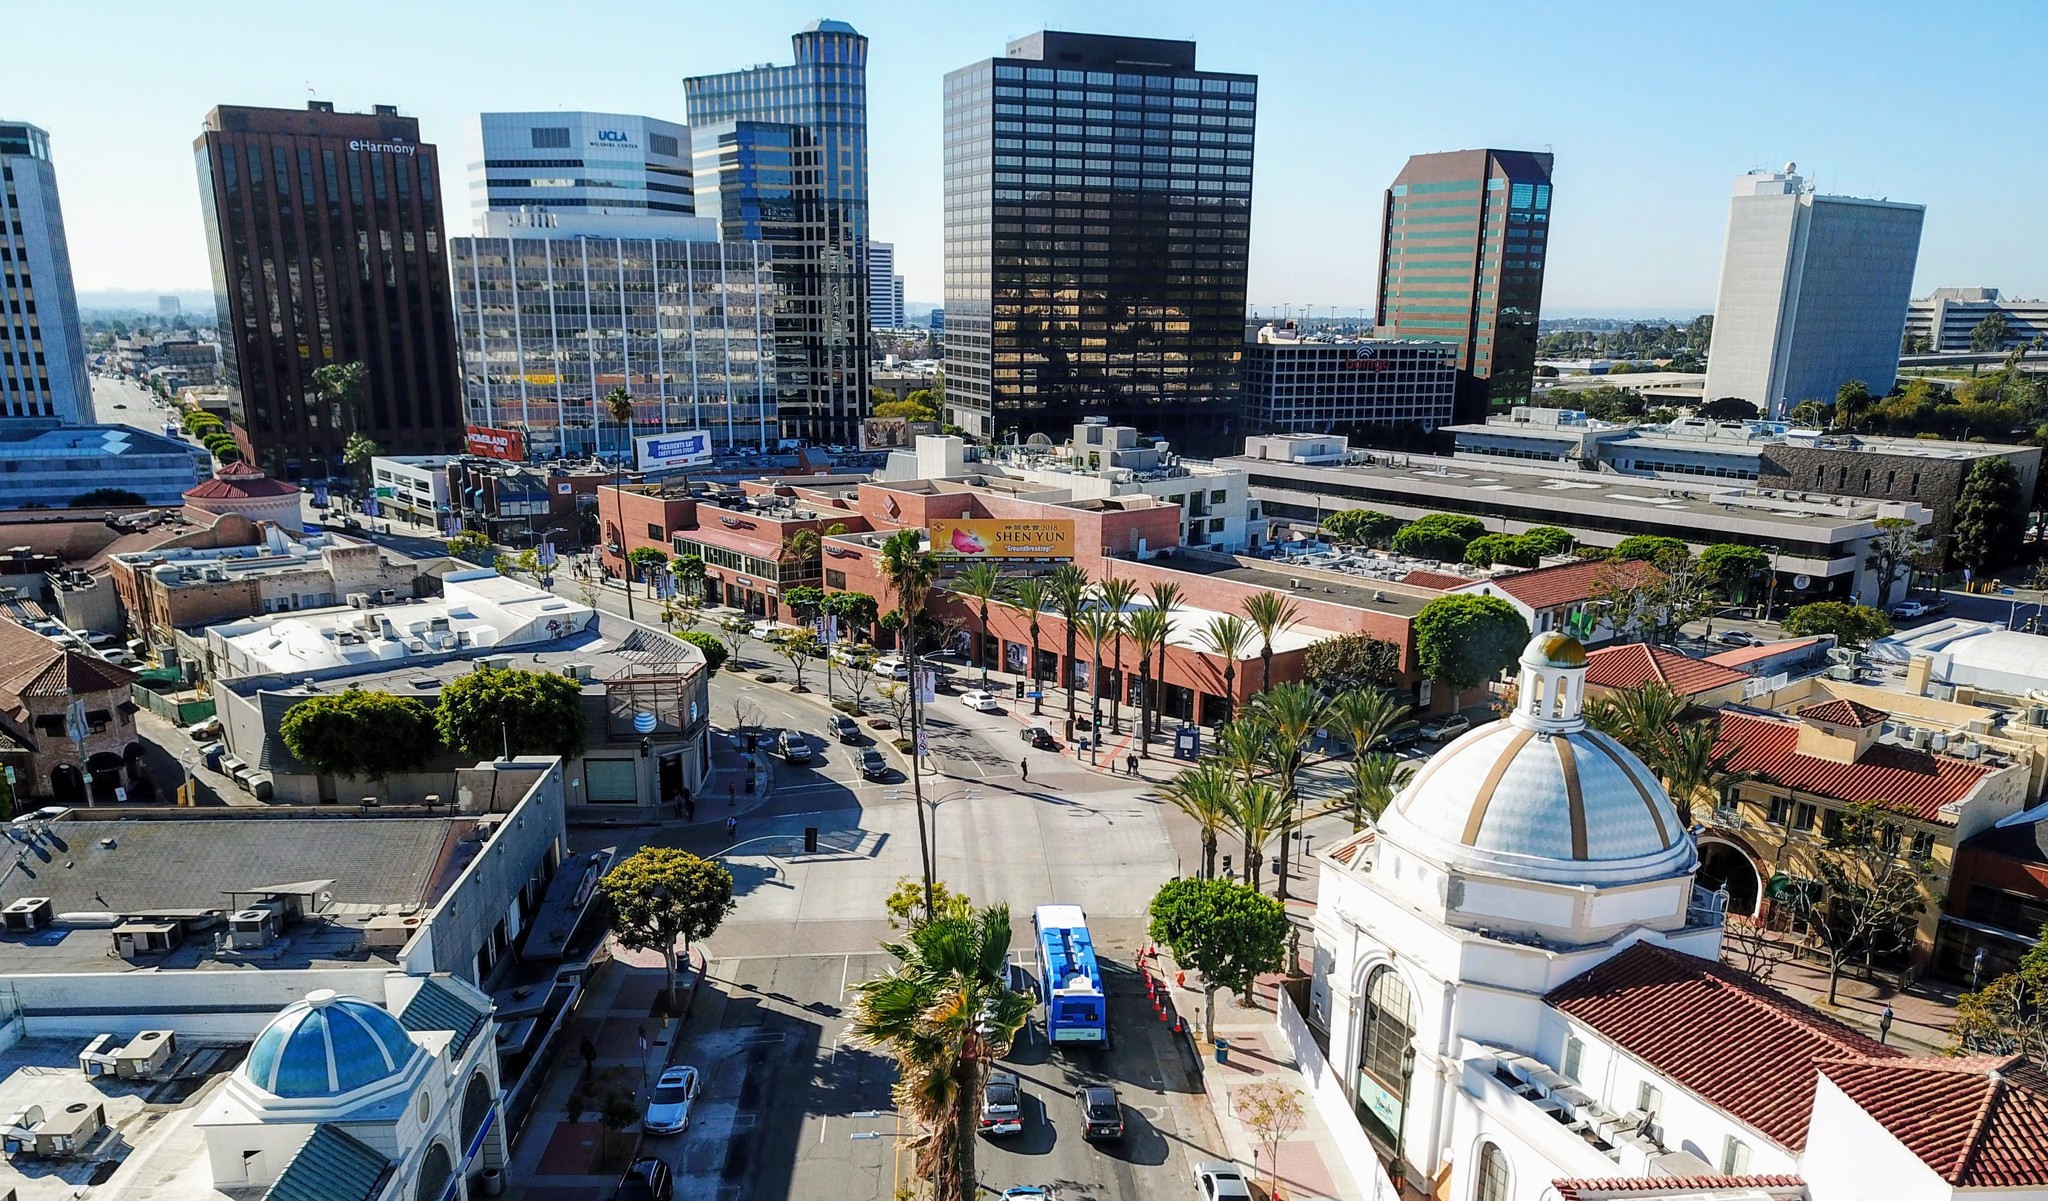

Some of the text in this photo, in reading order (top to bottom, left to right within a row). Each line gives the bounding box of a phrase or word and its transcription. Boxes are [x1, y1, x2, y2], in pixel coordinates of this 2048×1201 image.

[598, 130, 628, 142] UCLA
[349, 139, 415, 157] eHarmony
[1346, 357, 1391, 373] boingo
[468, 432, 508, 447] HOMELAND
[657, 440, 694, 451] PRESIDENTS DAY
[995, 531, 1065, 542] SHEN YUN
